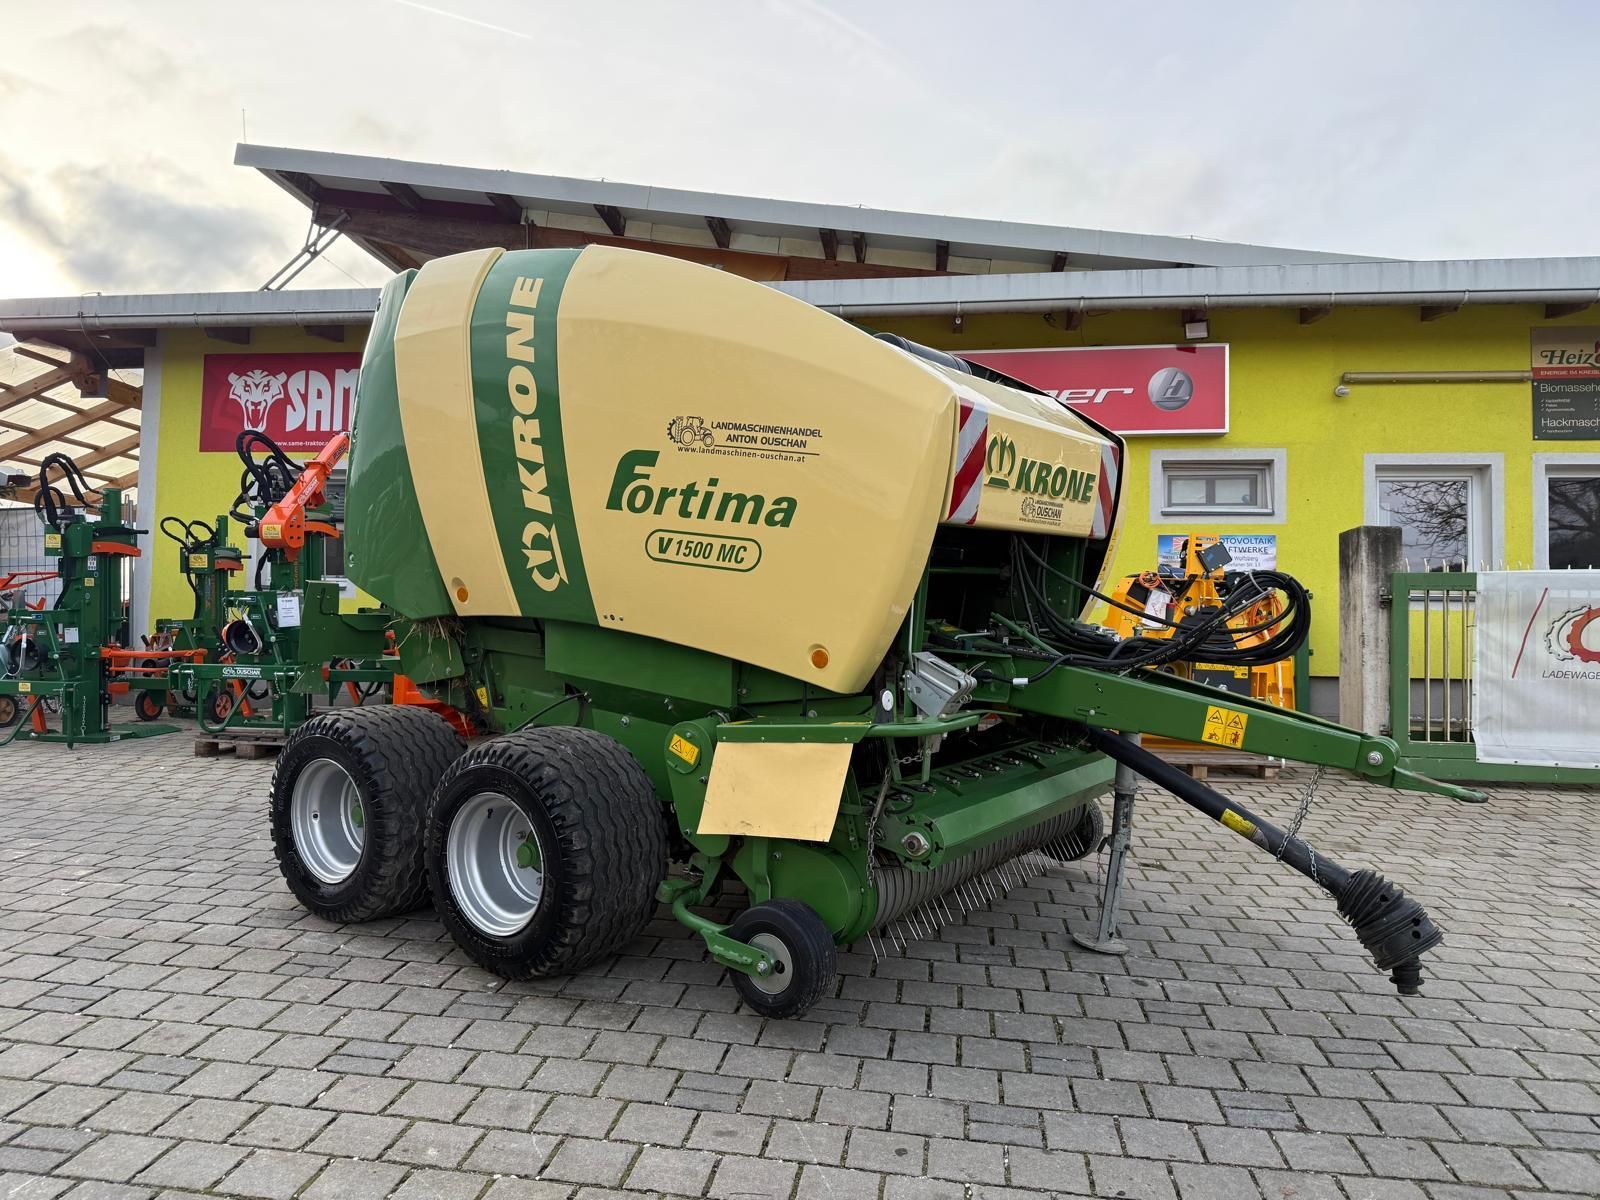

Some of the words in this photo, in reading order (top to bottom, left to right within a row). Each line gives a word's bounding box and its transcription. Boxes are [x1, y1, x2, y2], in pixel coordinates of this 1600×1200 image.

[506, 276, 552, 514] KRONE
[711, 421, 823, 438] LANDMASCHINENHANDEL
[726, 434, 758, 445] ANTON
[761, 437, 807, 449] OUSCHAN
[677, 446, 805, 463] www.landmaschinen-ouschan.at
[605, 449, 798, 528] Fortima
[1014, 457, 1097, 503] KRONE
[1036, 506, 1062, 519] OUSCHAN
[658, 536, 673, 554] V
[675, 539, 714, 560] 1500
[716, 543, 748, 565] MC
